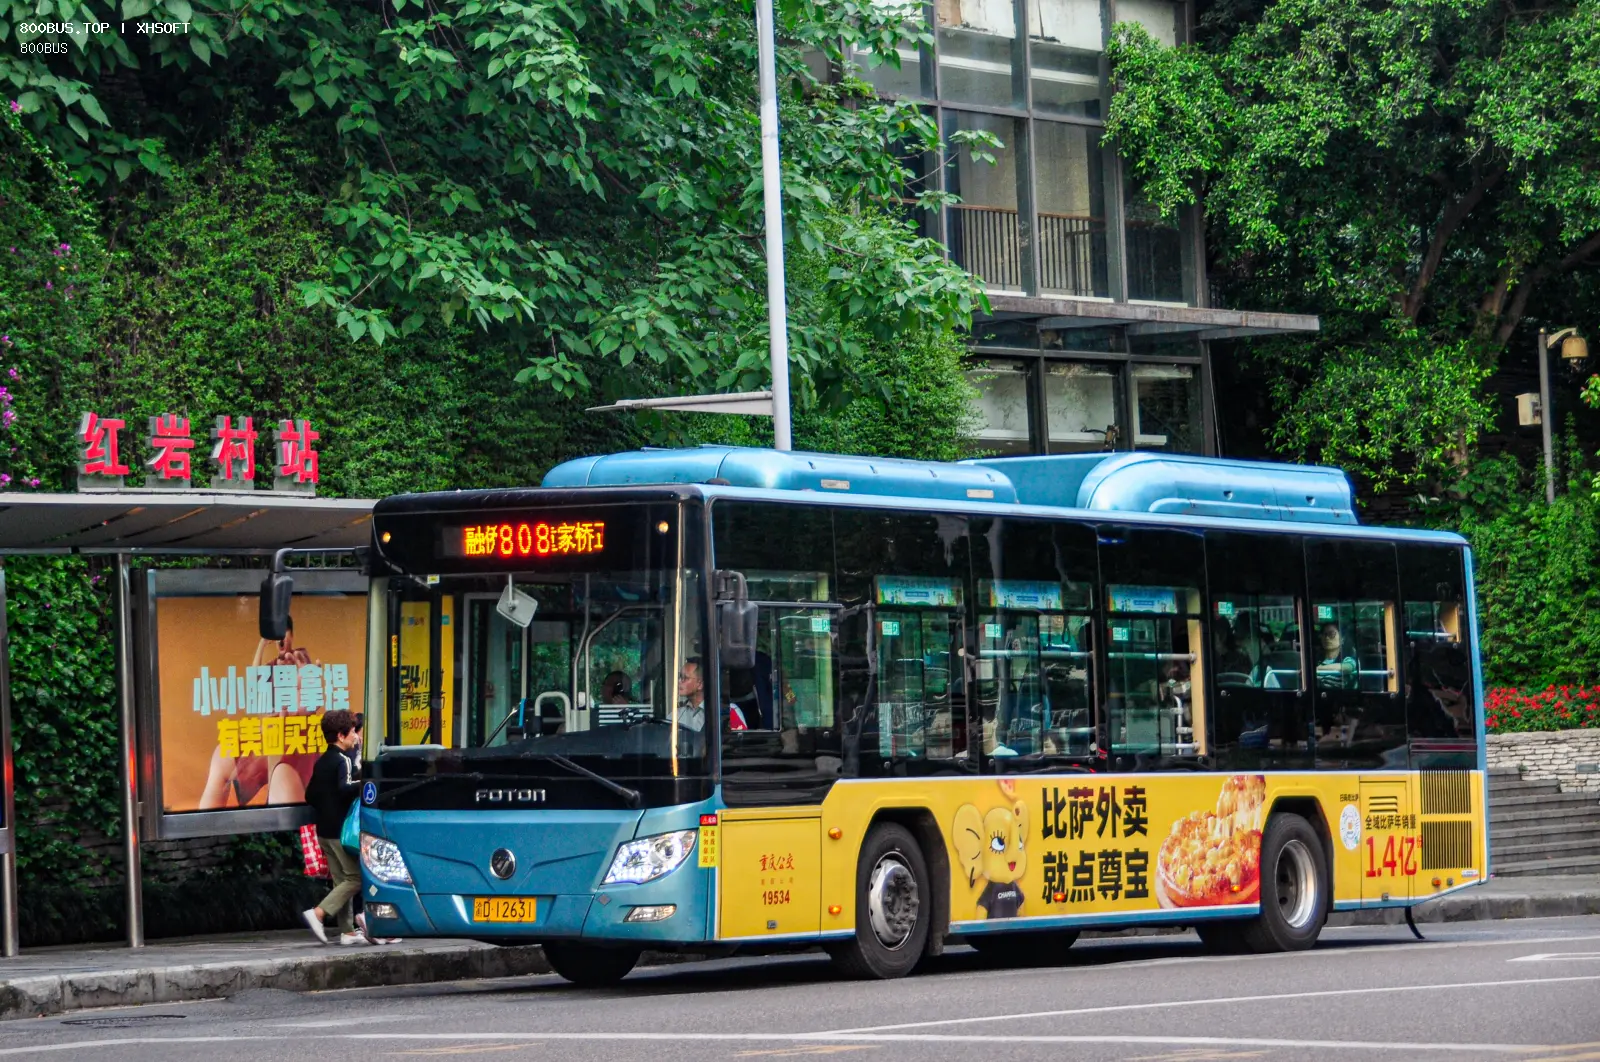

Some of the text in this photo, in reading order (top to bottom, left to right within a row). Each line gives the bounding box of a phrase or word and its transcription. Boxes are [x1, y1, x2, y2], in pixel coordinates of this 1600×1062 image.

[79, 411, 320, 485] 红岩村站
[500, 523, 550, 555] 808
[193, 663, 350, 716] 小小肠胃拿捏
[475, 788, 546, 802] FOTON
[1041, 785, 1149, 840] 比萨外卖
[1041, 847, 1150, 904] 就点尊宝
[1365, 835, 1418, 878] 1.4亿
[762, 889, 791, 905] 19534
